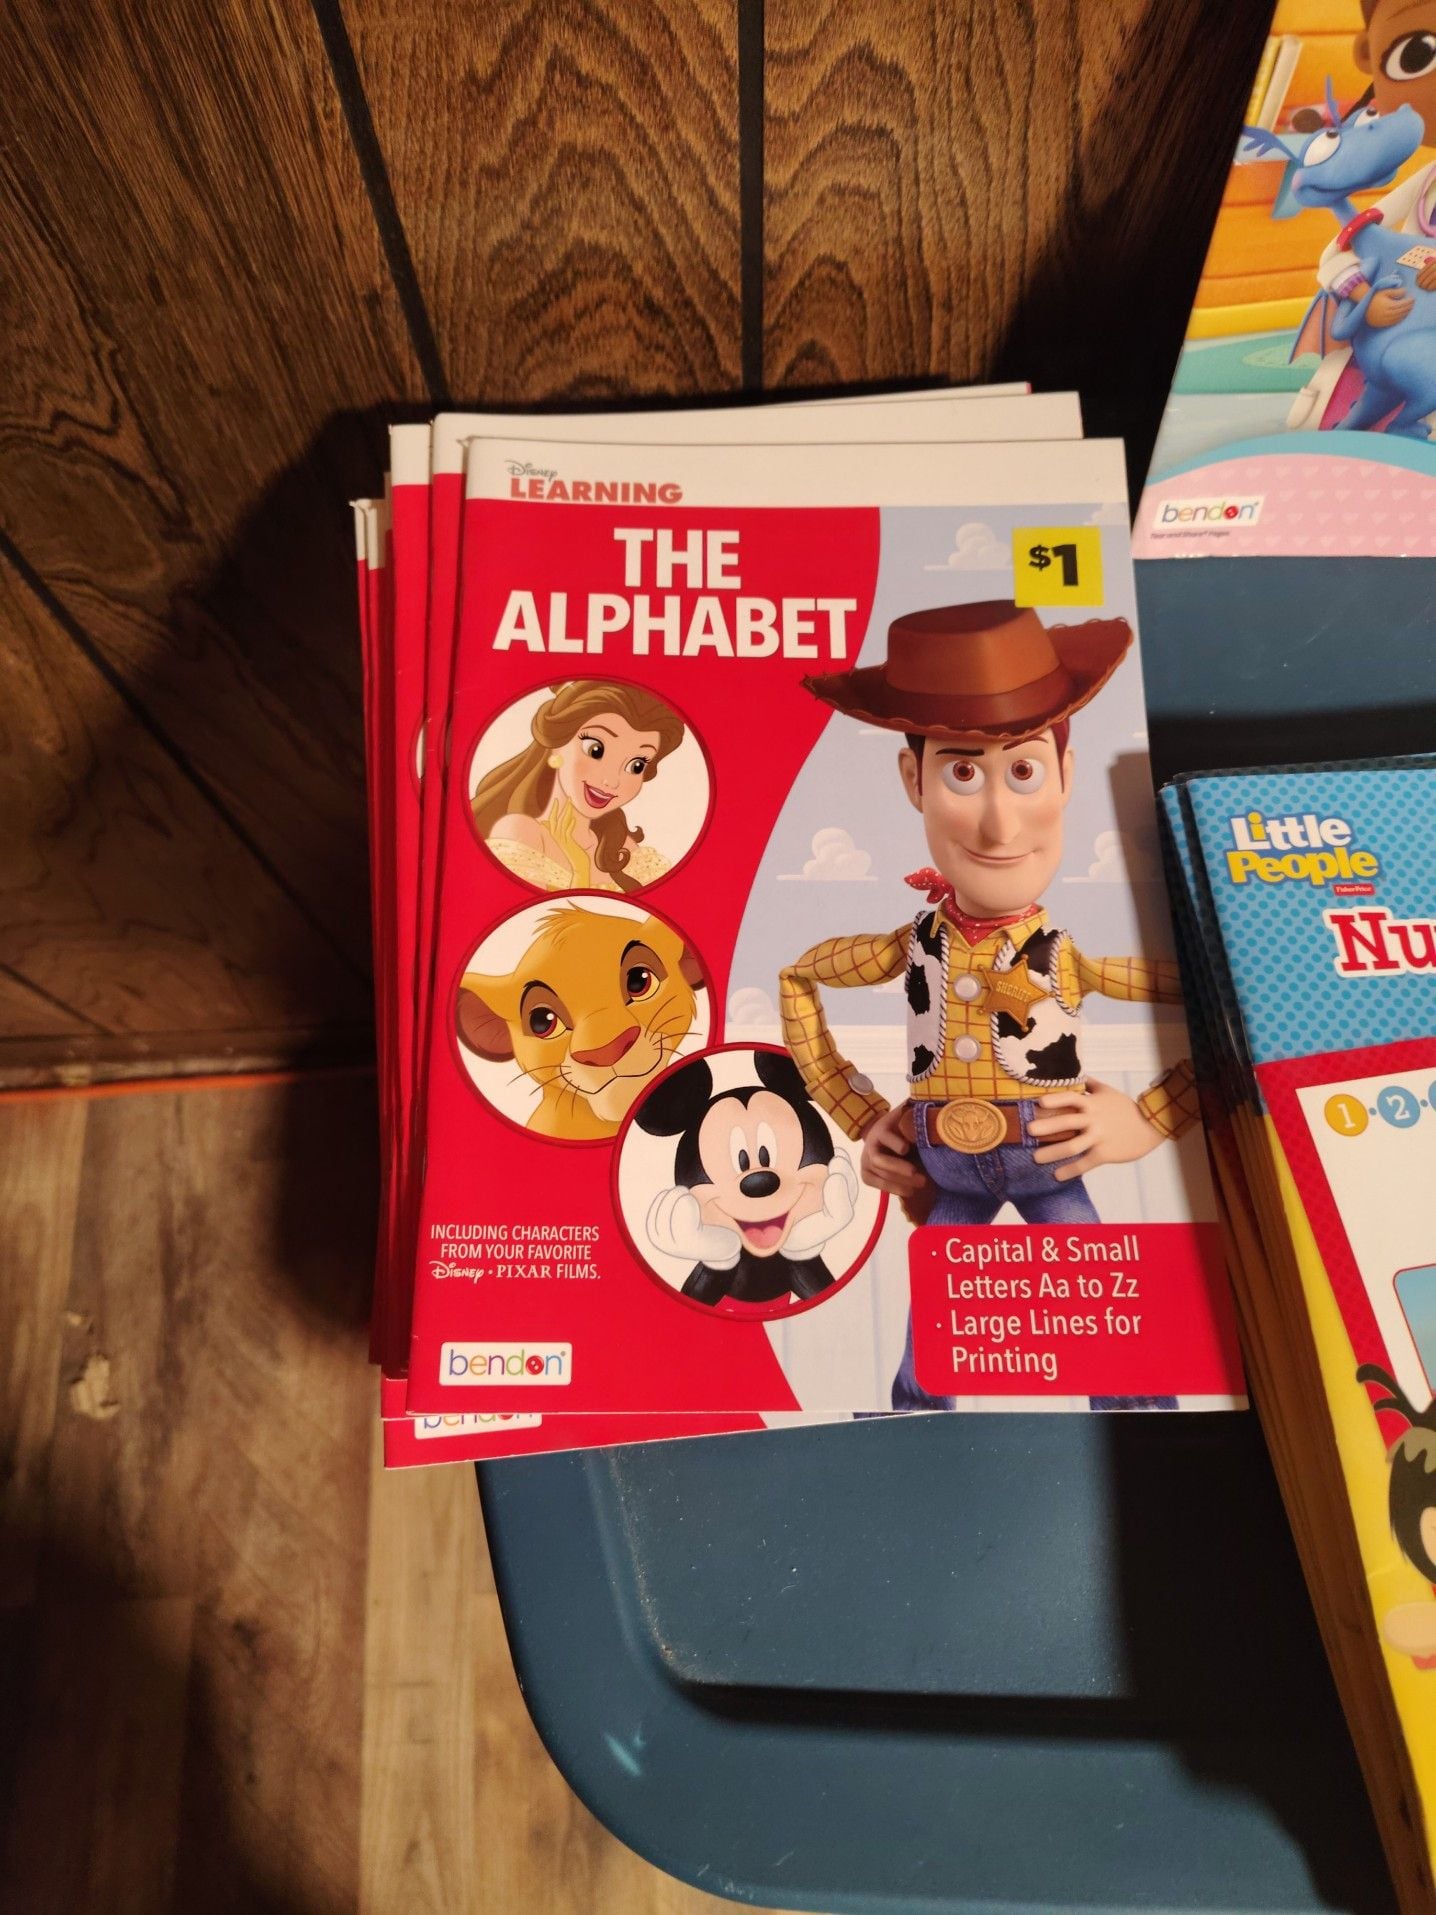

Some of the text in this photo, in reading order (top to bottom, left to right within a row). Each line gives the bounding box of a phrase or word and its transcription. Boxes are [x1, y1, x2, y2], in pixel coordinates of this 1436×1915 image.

[504, 459, 558, 481] Disney
[511, 477, 683, 504] LEARNING
[1161, 502, 1255, 523] bendon
[614, 527, 742, 590] THE
[1028, 543, 1079, 588] $1
[492, 589, 858, 660] ALPHABET
[1229, 811, 1352, 851] Little
[1226, 847, 1379, 886] People
[1328, 911, 1436, 972] Nu
[1337, 1094, 1412, 1129] 1 2
[430, 1223, 600, 1242] INCLUDING CHARACTERS
[440, 1243, 592, 1261] FROM YOUR FAVORITE
[945, 1234, 1141, 1270] Capital & Small
[428, 1260, 602, 1284] Disney PIXAR FILMS.
[947, 1272, 1141, 1299] Letters Aa to Zz
[950, 1306, 1142, 1343] Large Lines for
[448, 1348, 563, 1376] bendon
[952, 1346, 1058, 1381] Printing
